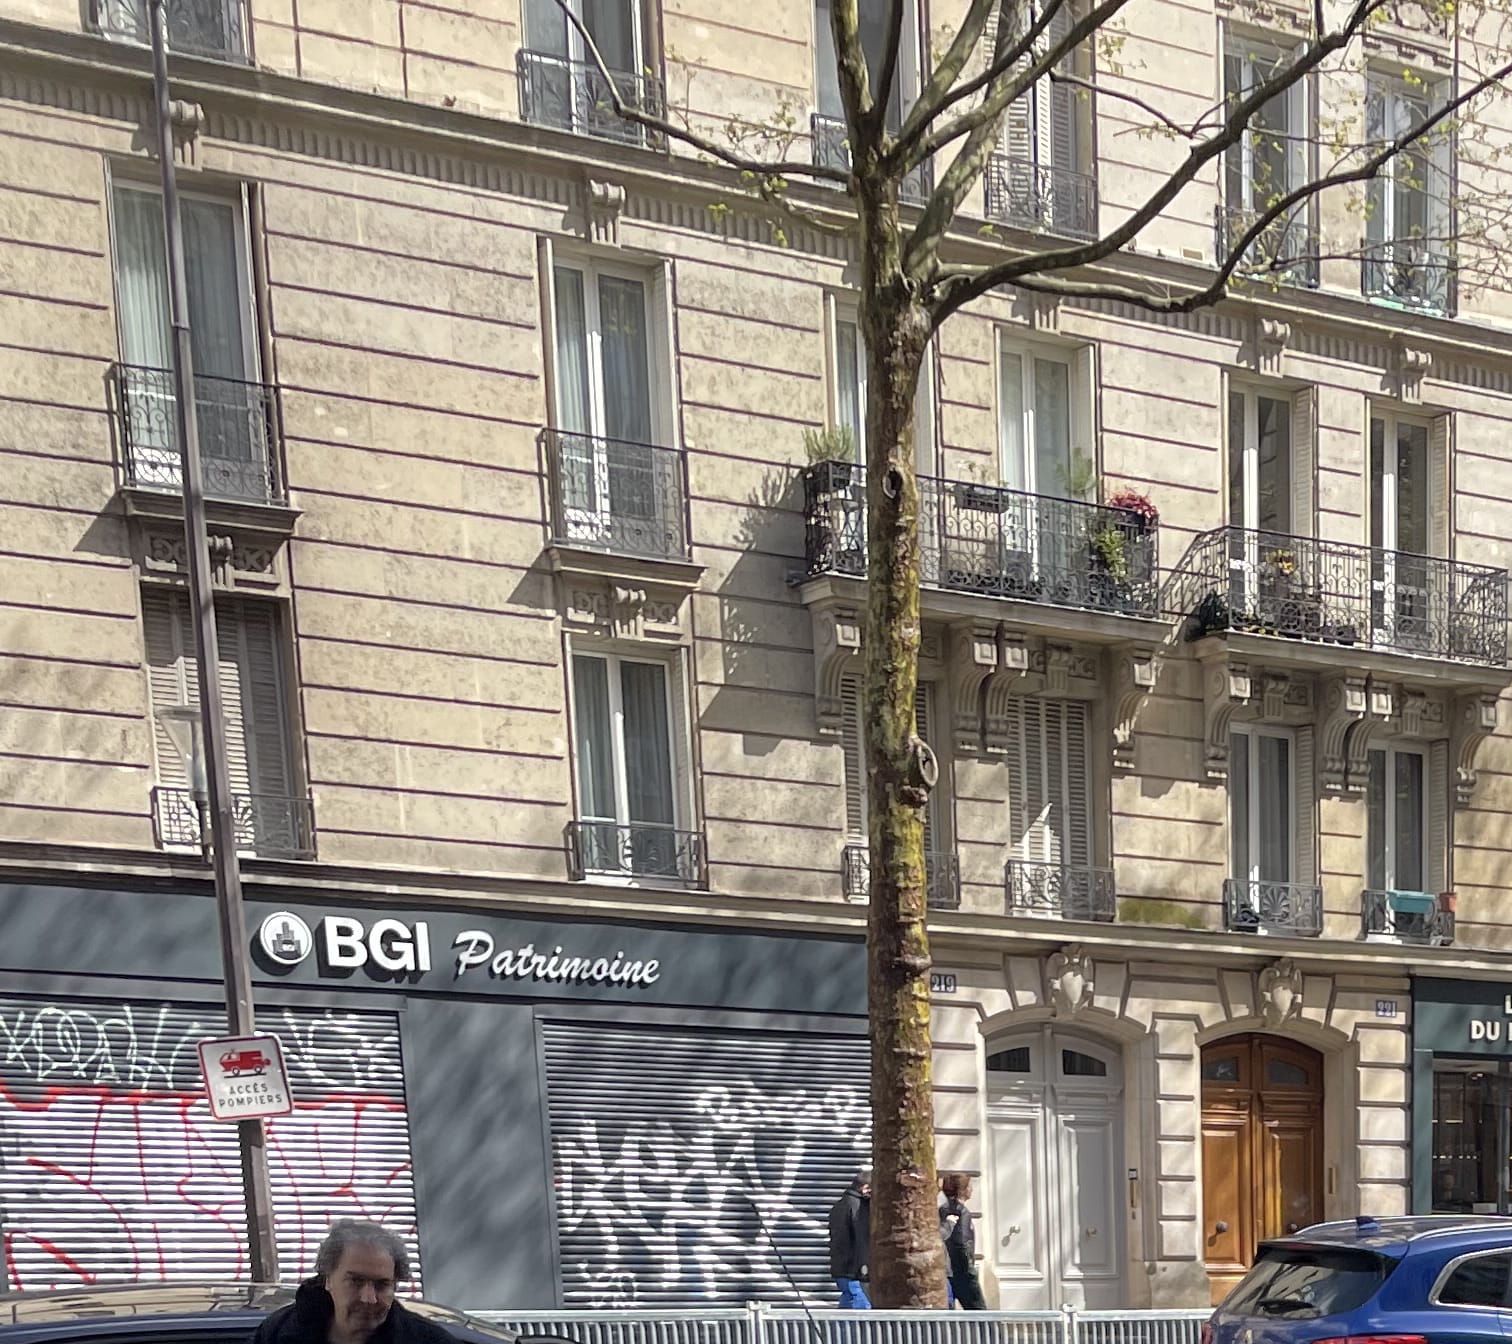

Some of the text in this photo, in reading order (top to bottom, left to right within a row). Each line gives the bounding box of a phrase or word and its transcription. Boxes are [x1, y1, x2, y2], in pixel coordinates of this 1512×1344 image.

[324, 916, 661, 984] BGI Patrimoine
[931, 975, 954, 992] 219
[1471, 1020, 1500, 1041] DU
[219, 1094, 282, 1108] POMPIERS
